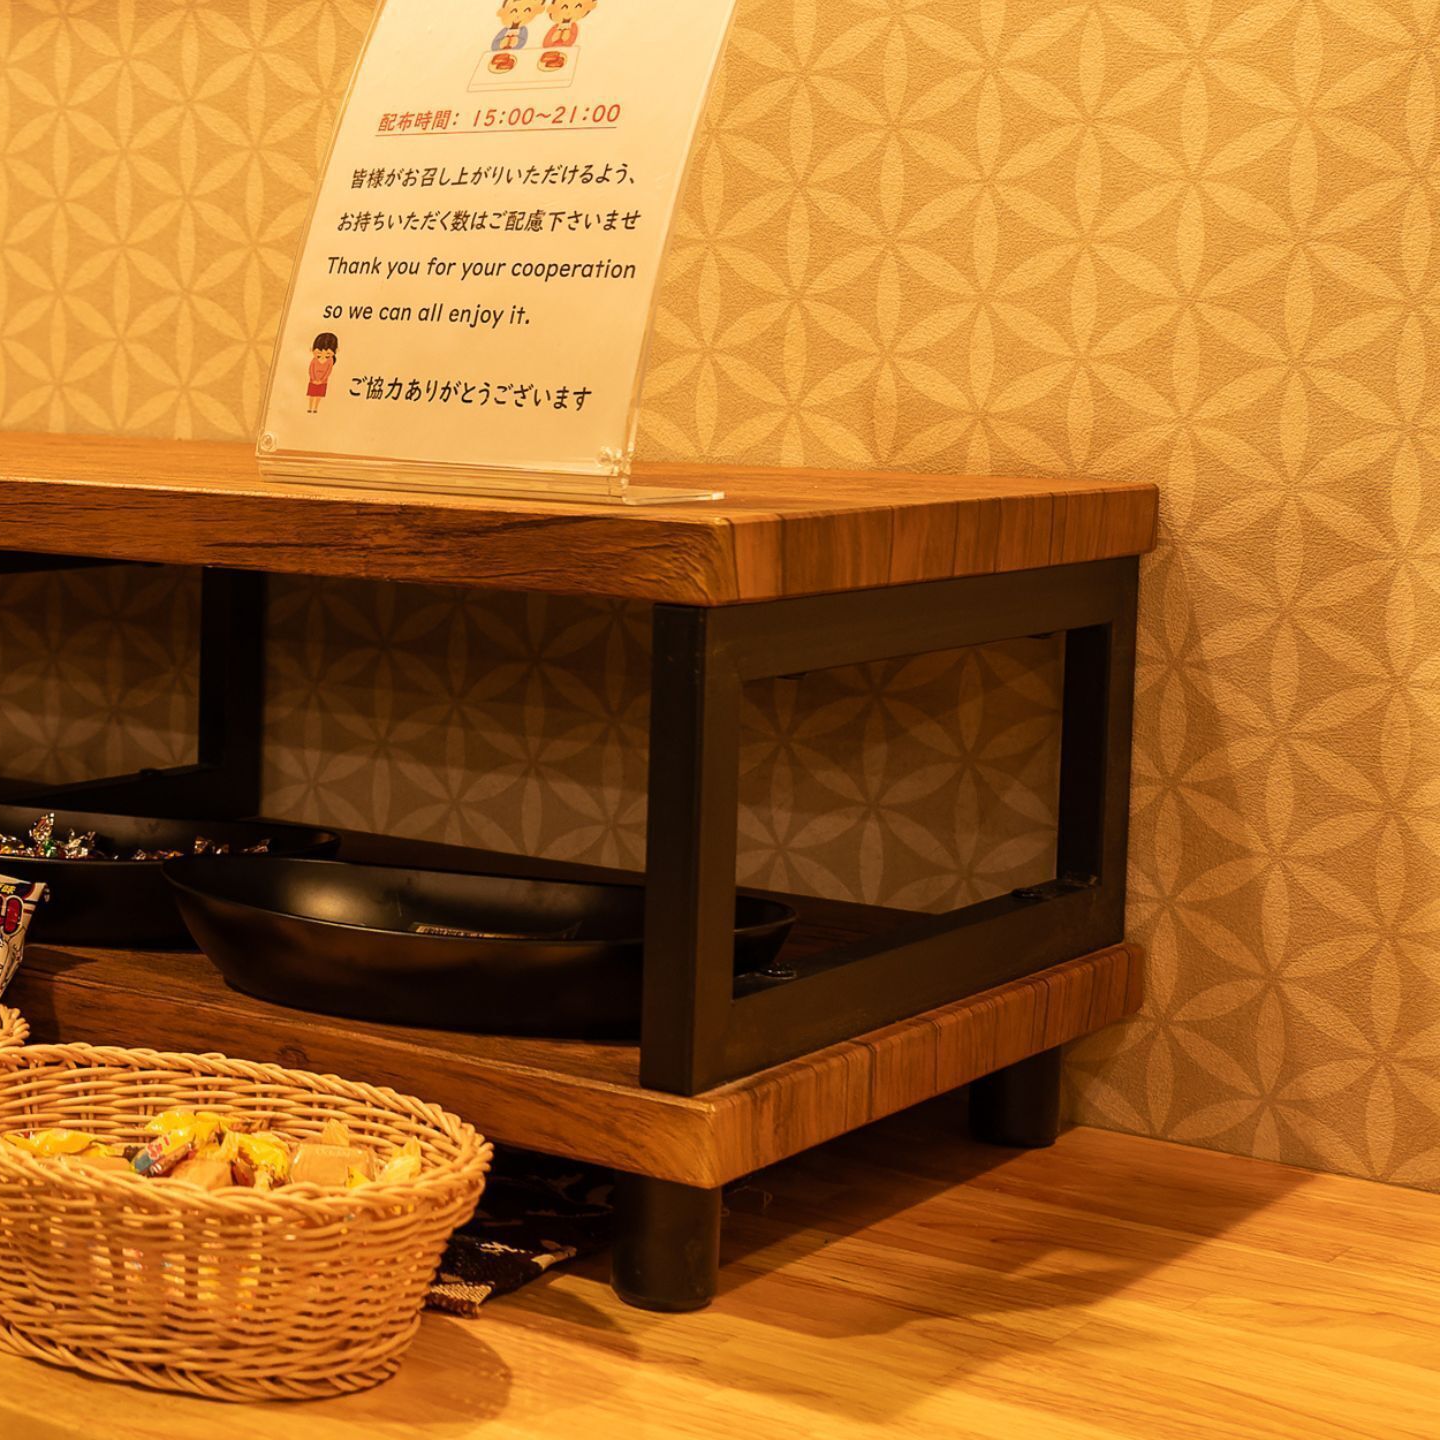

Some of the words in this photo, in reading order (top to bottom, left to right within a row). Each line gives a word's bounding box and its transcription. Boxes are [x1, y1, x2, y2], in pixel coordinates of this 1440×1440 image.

[350, 162, 635, 189] 皆様がお召し上がりいただけるよう、
[337, 209, 642, 234] お持ちいただく数はご配慮下さいませ
[327, 256, 382, 276] Thank
[386, 261, 420, 280] you
[427, 256, 457, 276] for
[460, 262, 507, 281] your
[510, 258, 636, 283] cooperation
[323, 305, 343, 319] so
[349, 305, 373, 320] we
[378, 306, 412, 321] can
[417, 303, 444, 322] all
[448, 304, 505, 329] enjoy
[509, 304, 530, 325] it.
[349, 375, 593, 412] ご協力ありがとうございます
